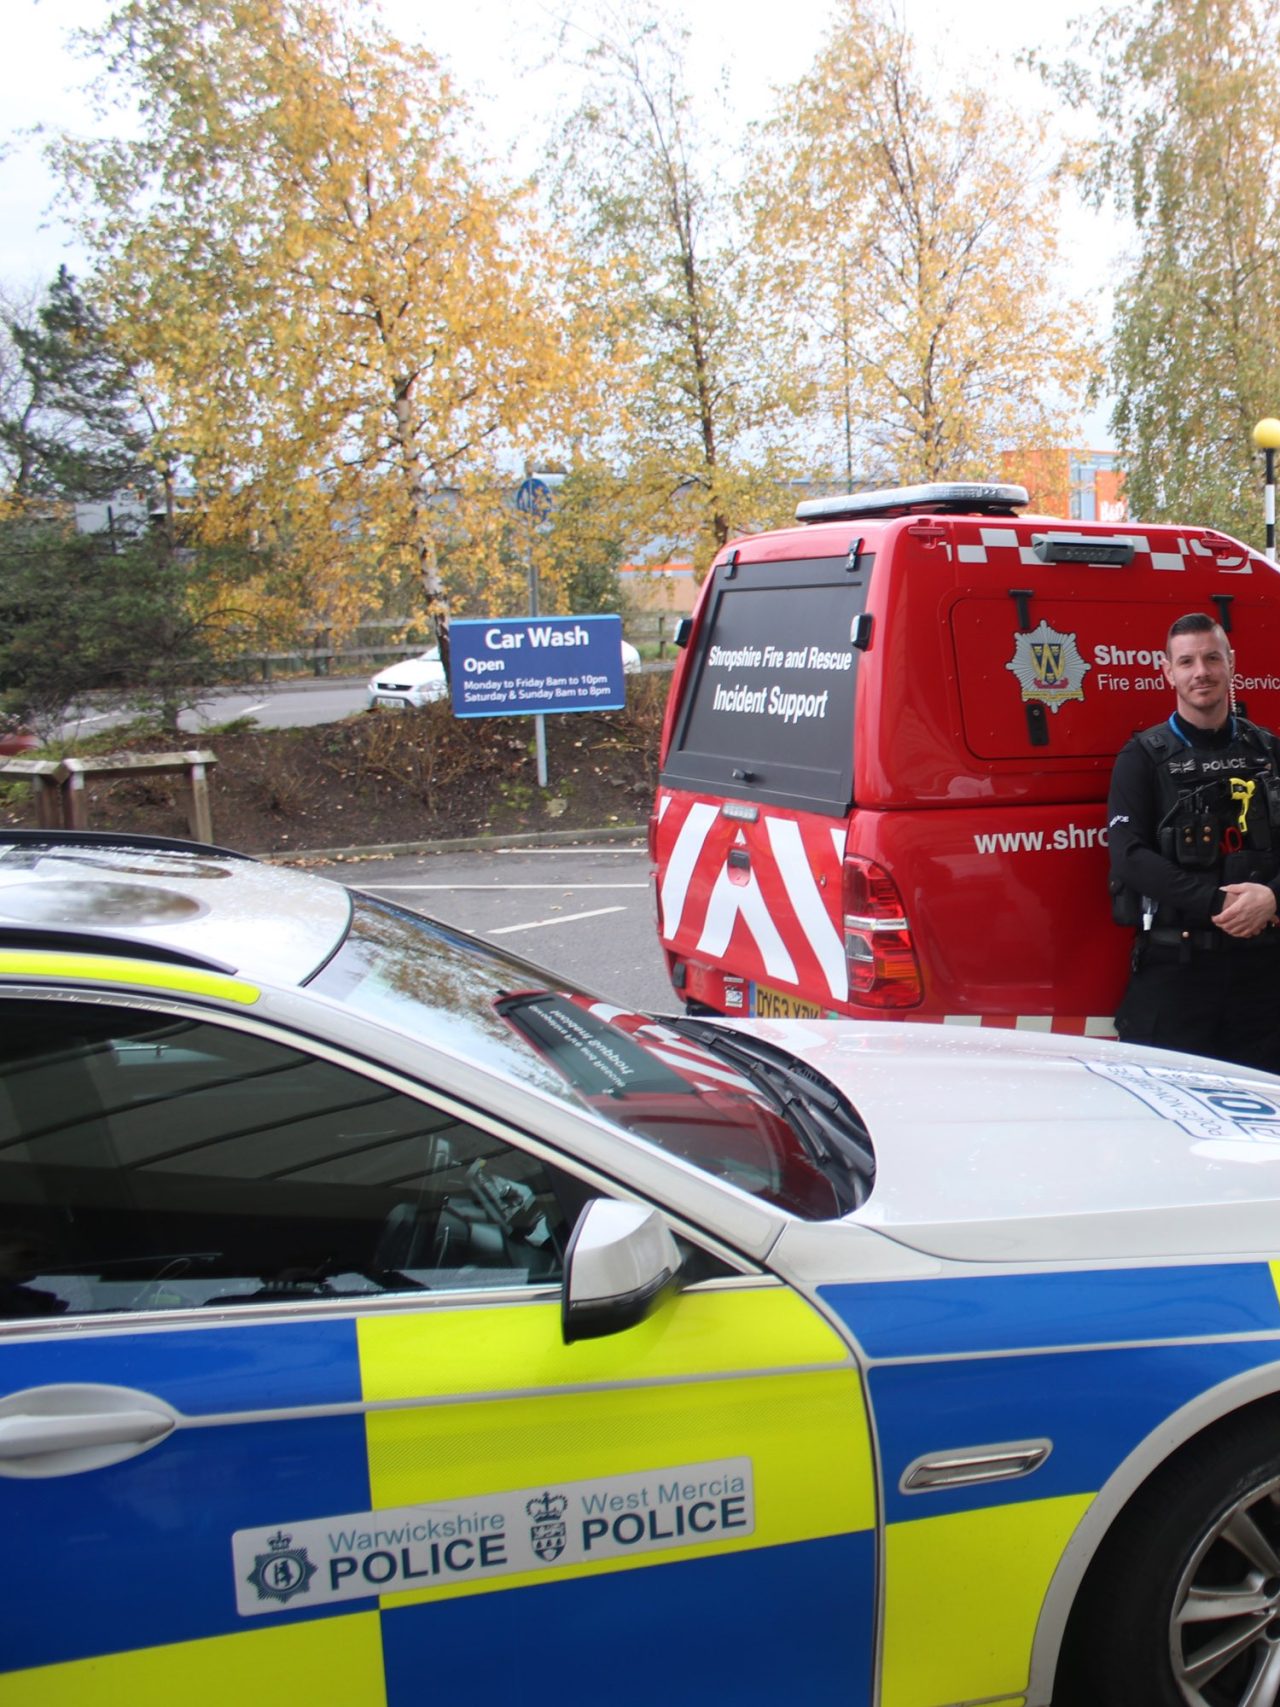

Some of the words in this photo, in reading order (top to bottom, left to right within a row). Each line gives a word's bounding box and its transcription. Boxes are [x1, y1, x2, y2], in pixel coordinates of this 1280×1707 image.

[485, 628, 525, 650] Car
[527, 625, 590, 648] Wash
[463, 657, 505, 674] Open
[708, 645, 762, 672] Shropshire
[762, 646, 784, 668] Fire
[784, 647, 808, 668] and
[807, 647, 852, 671] Rescue
[464, 679, 502, 691] Monday
[504, 680, 514, 689] to
[516, 677, 545, 689] Friday
[546, 677, 567, 687] 8am
[568, 677, 579, 686] to
[581, 675, 608, 686] 10pm
[464, 690, 507, 703] Saturday
[508, 690, 517, 700] &
[518, 688, 553, 701] Sunday
[555, 688, 576, 698] 8am
[577, 688, 588, 696] to
[589, 686, 611, 697] 8pm
[1097, 674, 1130, 690] Fire
[1134, 674, 1165, 690] and
[712, 684, 768, 714] Incident
[768, 686, 828, 724] Support
[1202, 758, 1247, 772] POLICE
[581, 1487, 649, 1515] West
[657, 1474, 746, 1504] Mercia
[328, 1511, 506, 1554] Warwickshire
[581, 1495, 747, 1551] POLICE
[329, 1532, 508, 1592] POLICE
